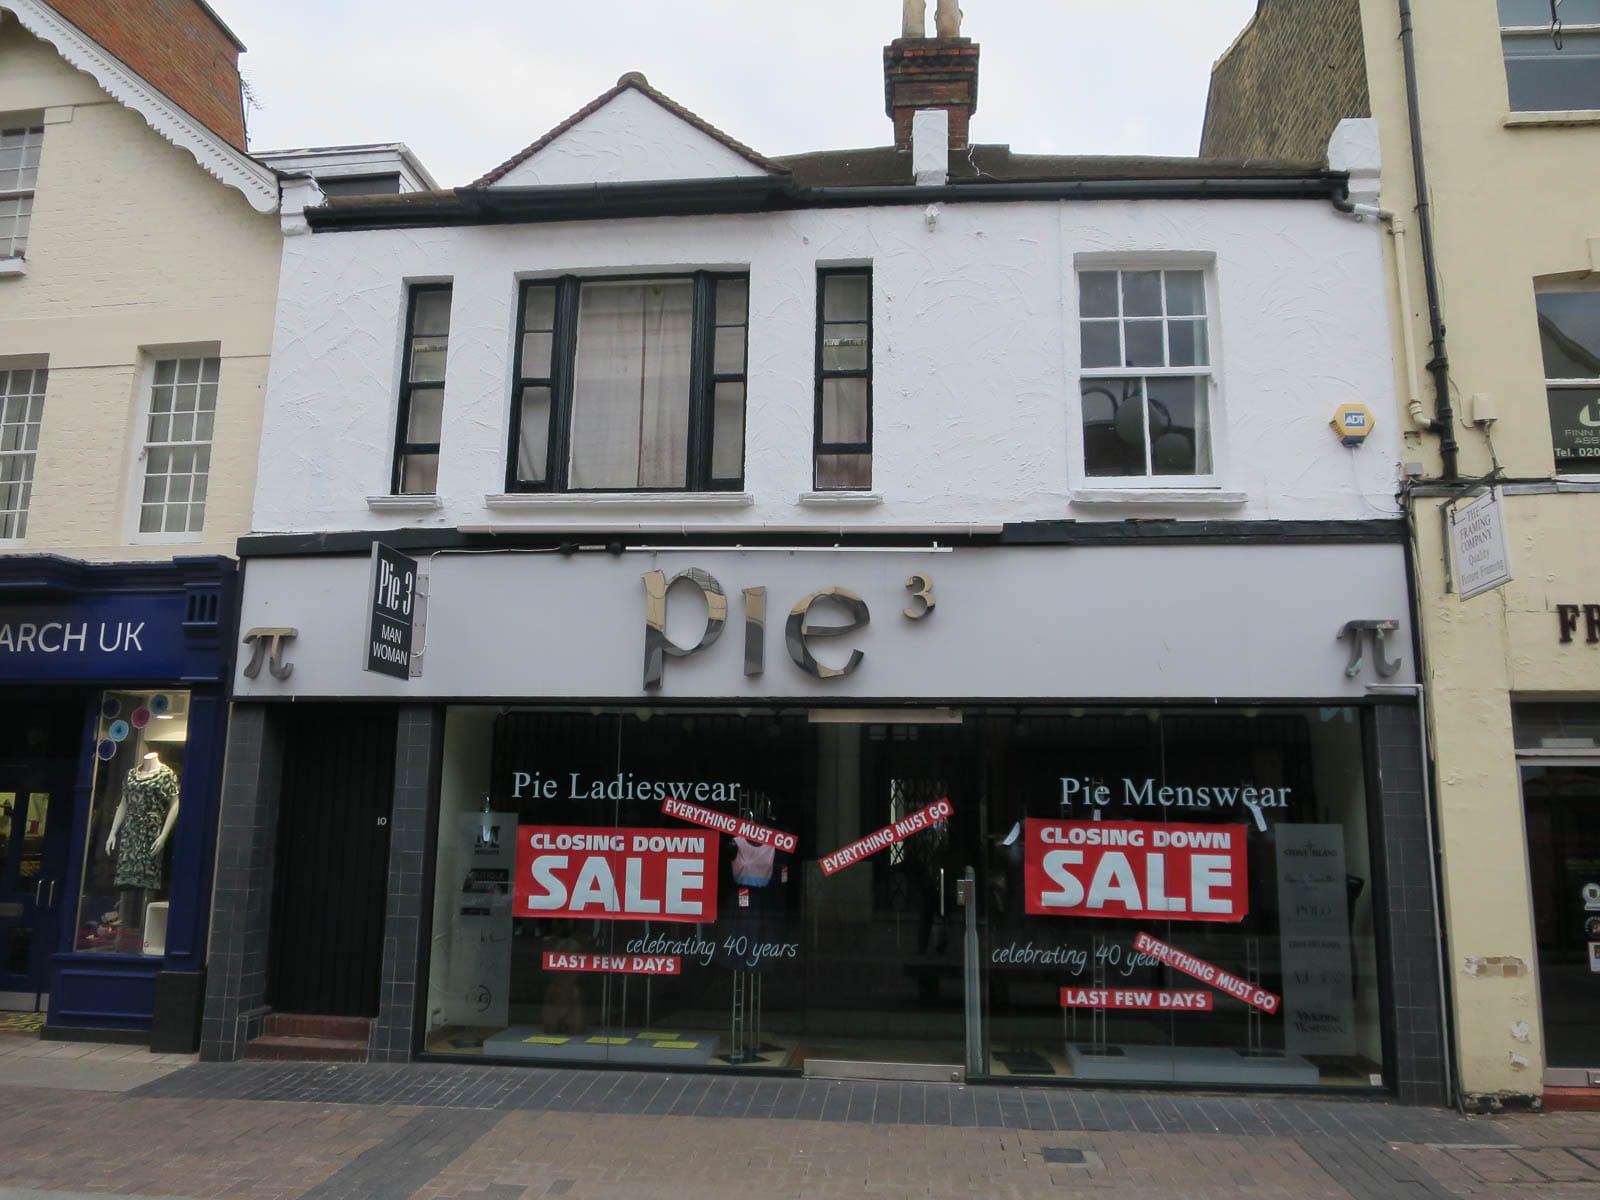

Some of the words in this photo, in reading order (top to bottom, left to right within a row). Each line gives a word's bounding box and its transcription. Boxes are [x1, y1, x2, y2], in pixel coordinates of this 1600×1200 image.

[1345, 414, 1365, 425] ADT
[1564, 429, 1594, 437] FINN
[1555, 448, 1575, 457] Tel.
[1466, 505, 1480, 522] THE
[1459, 514, 1491, 540] FRAMING
[1460, 528, 1492, 554] COMPANY
[378, 559, 401, 611] Pie
[402, 571, 413, 616] 3
[99, 622, 145, 652] UK
[381, 624, 402, 644] MAN
[373, 641, 408, 666] WOMAN
[512, 771, 558, 799] Pie
[568, 773, 741, 802] Ladieswear
[1059, 777, 1110, 805] Pie
[1123, 778, 1291, 808] Menswear
[377, 816, 387, 826] 10
[664, 799, 737, 833] EVERYTHING
[738, 821, 772, 847] MUST
[774, 834, 795, 850] GO
[530, 833, 625, 852] CLOSING
[632, 836, 705, 853] DOWN
[823, 828, 895, 873] EVERYTHING
[895, 813, 927, 838] MUST
[928, 801, 949, 820] GO
[1040, 827, 1144, 847] CLOSING
[1153, 829, 1231, 850] DOWN
[528, 855, 704, 915] SALE
[1041, 850, 1232, 914] SALE
[626, 932, 716, 966] celebrating
[723, 936, 747, 957] 40
[745, 942, 799, 967] years
[992, 941, 1087, 976] celebrating
[1095, 944, 1121, 966] 40
[549, 954, 586, 970] LAST
[592, 955, 627, 971] FEW
[632, 956, 675, 972] DAYS
[1138, 935, 1215, 981] EVERYTHING
[1216, 973, 1253, 998] MUST
[1253, 990, 1276, 1010] GO
[1067, 990, 1109, 1006] LAST
[1115, 991, 1152, 1007] FEW
[1159, 992, 1207, 1009] DAYS
